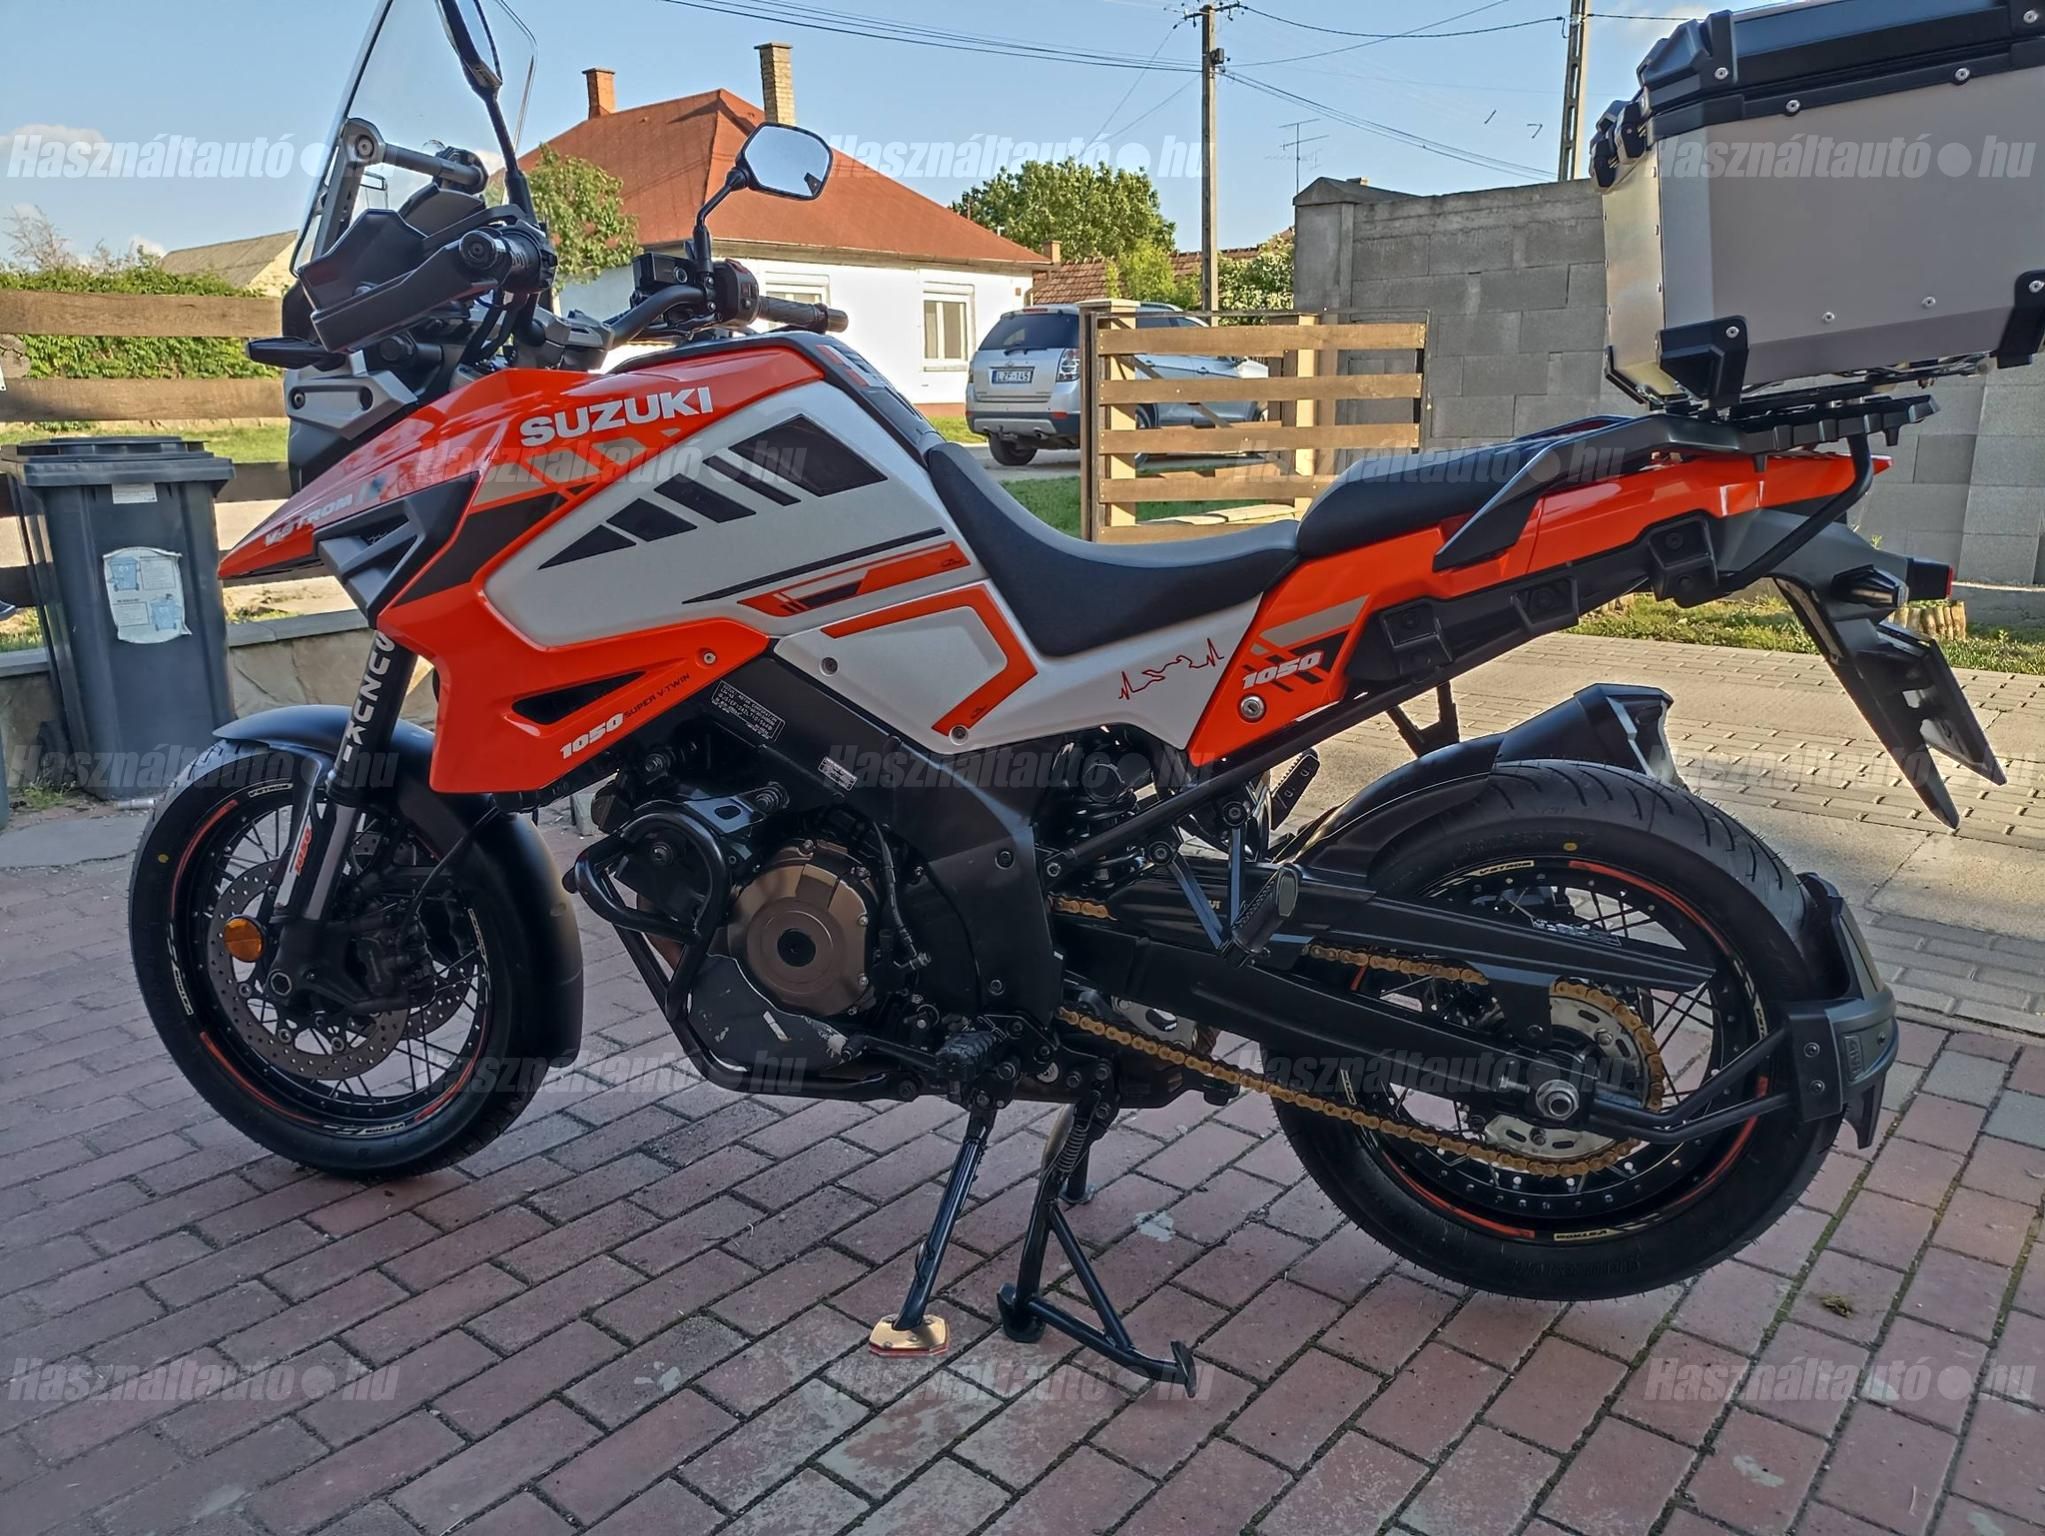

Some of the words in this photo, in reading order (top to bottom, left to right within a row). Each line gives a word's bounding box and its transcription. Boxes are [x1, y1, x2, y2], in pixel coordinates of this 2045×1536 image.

[519, 386, 714, 447] SUZUKI
[343, 630, 395, 762] SUZUKI
[1243, 651, 1322, 690] 1050
[559, 712, 624, 760] 1050
[624, 695, 657, 718] SUPER
[657, 673, 690, 697] V-TWIN
